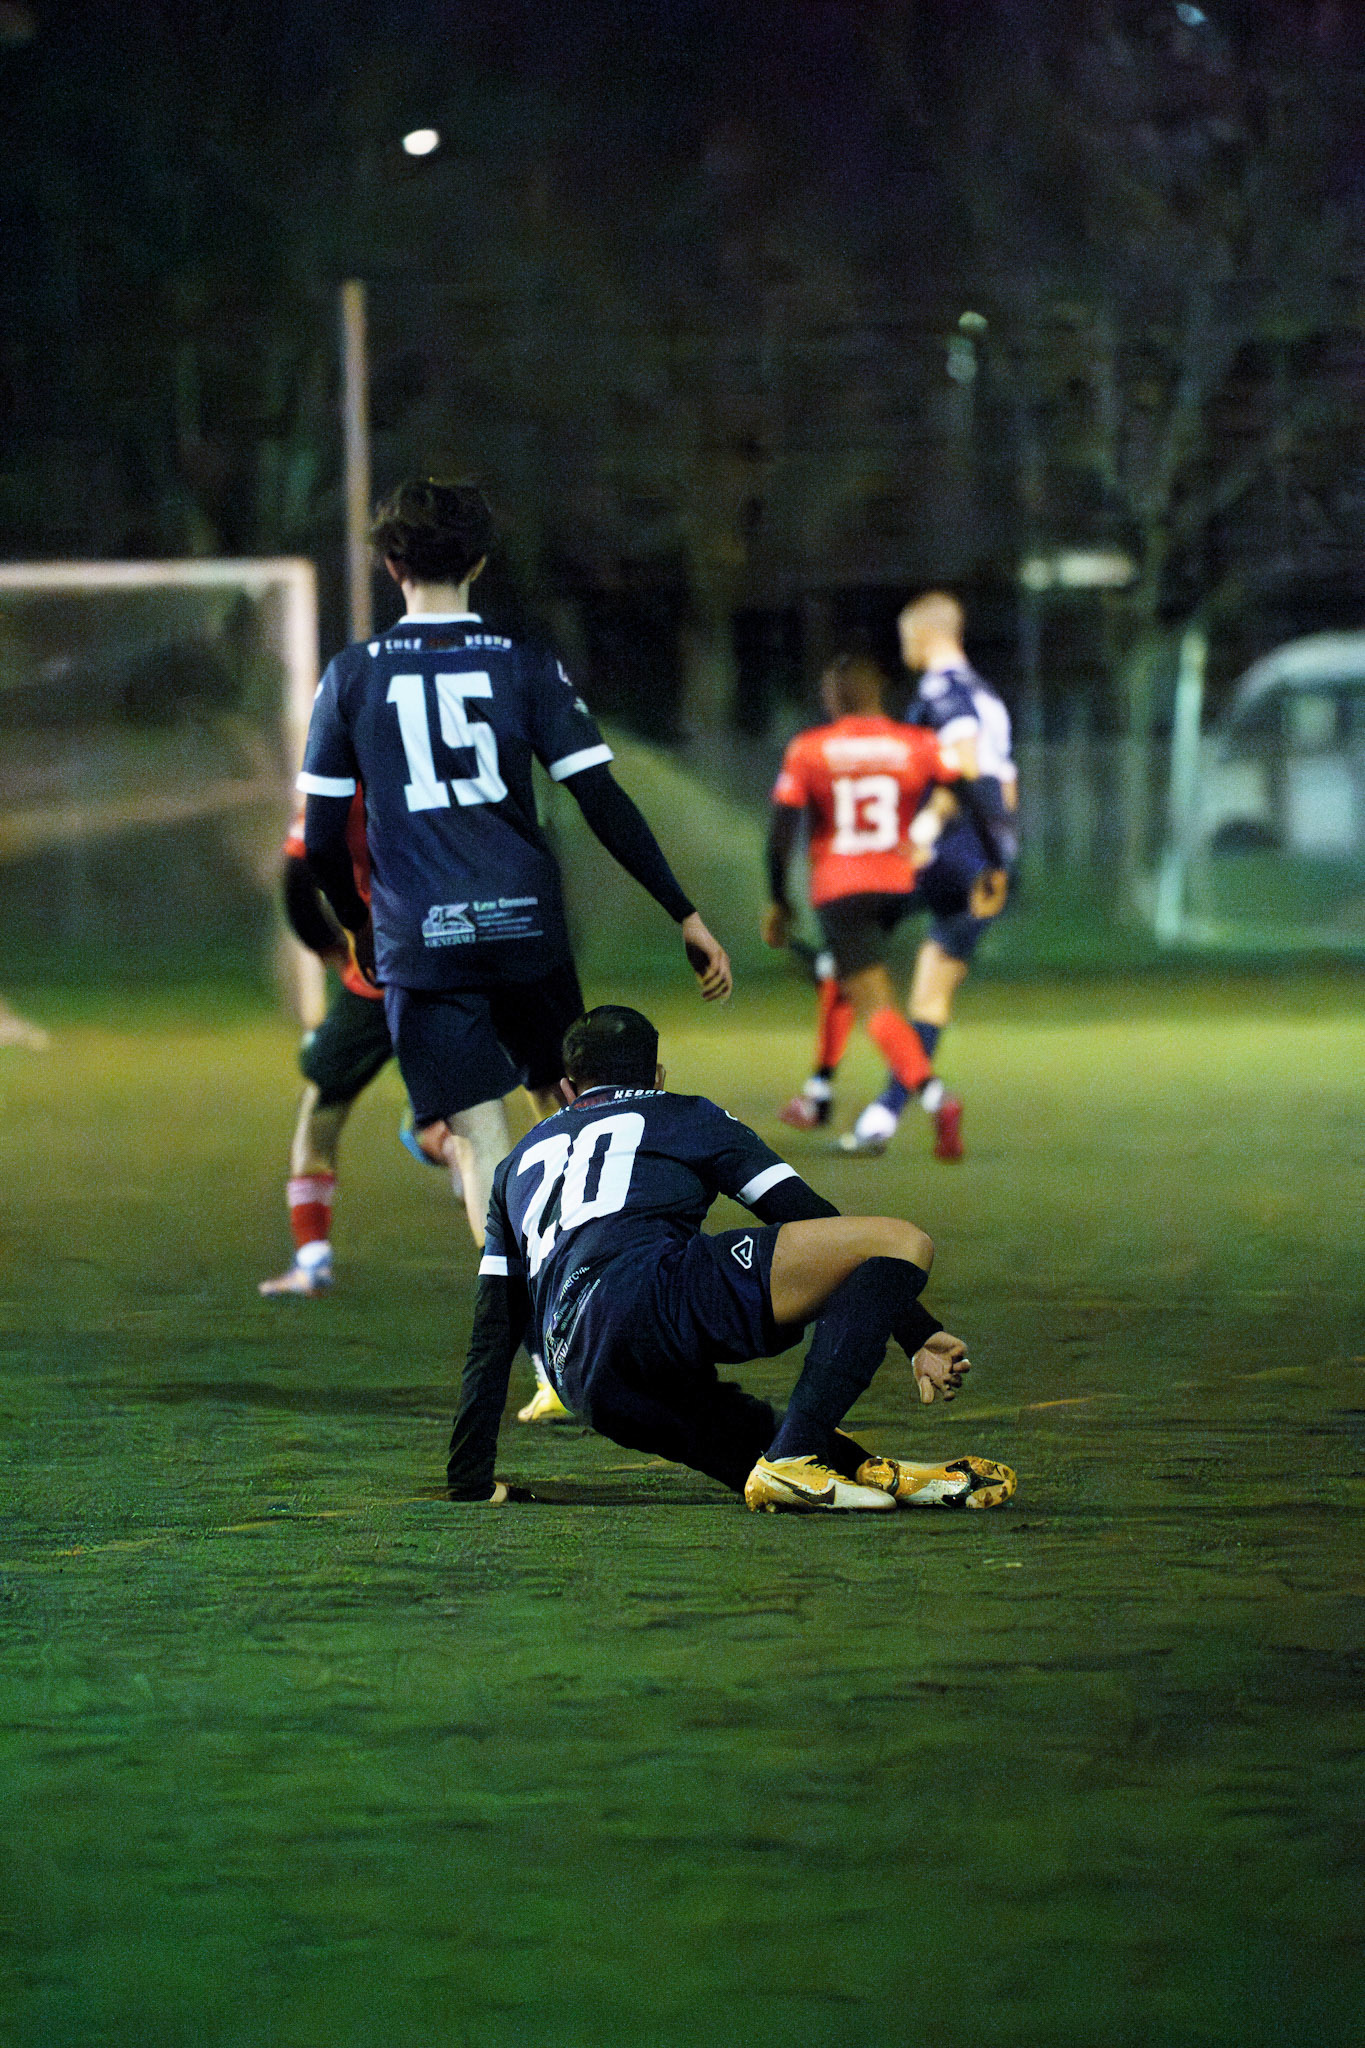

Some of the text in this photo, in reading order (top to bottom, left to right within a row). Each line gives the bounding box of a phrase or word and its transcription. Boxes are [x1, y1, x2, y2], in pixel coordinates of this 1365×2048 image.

[386, 671, 508, 812] 15
[832, 775, 899, 855] 13
[517, 1112, 646, 1279] 20
